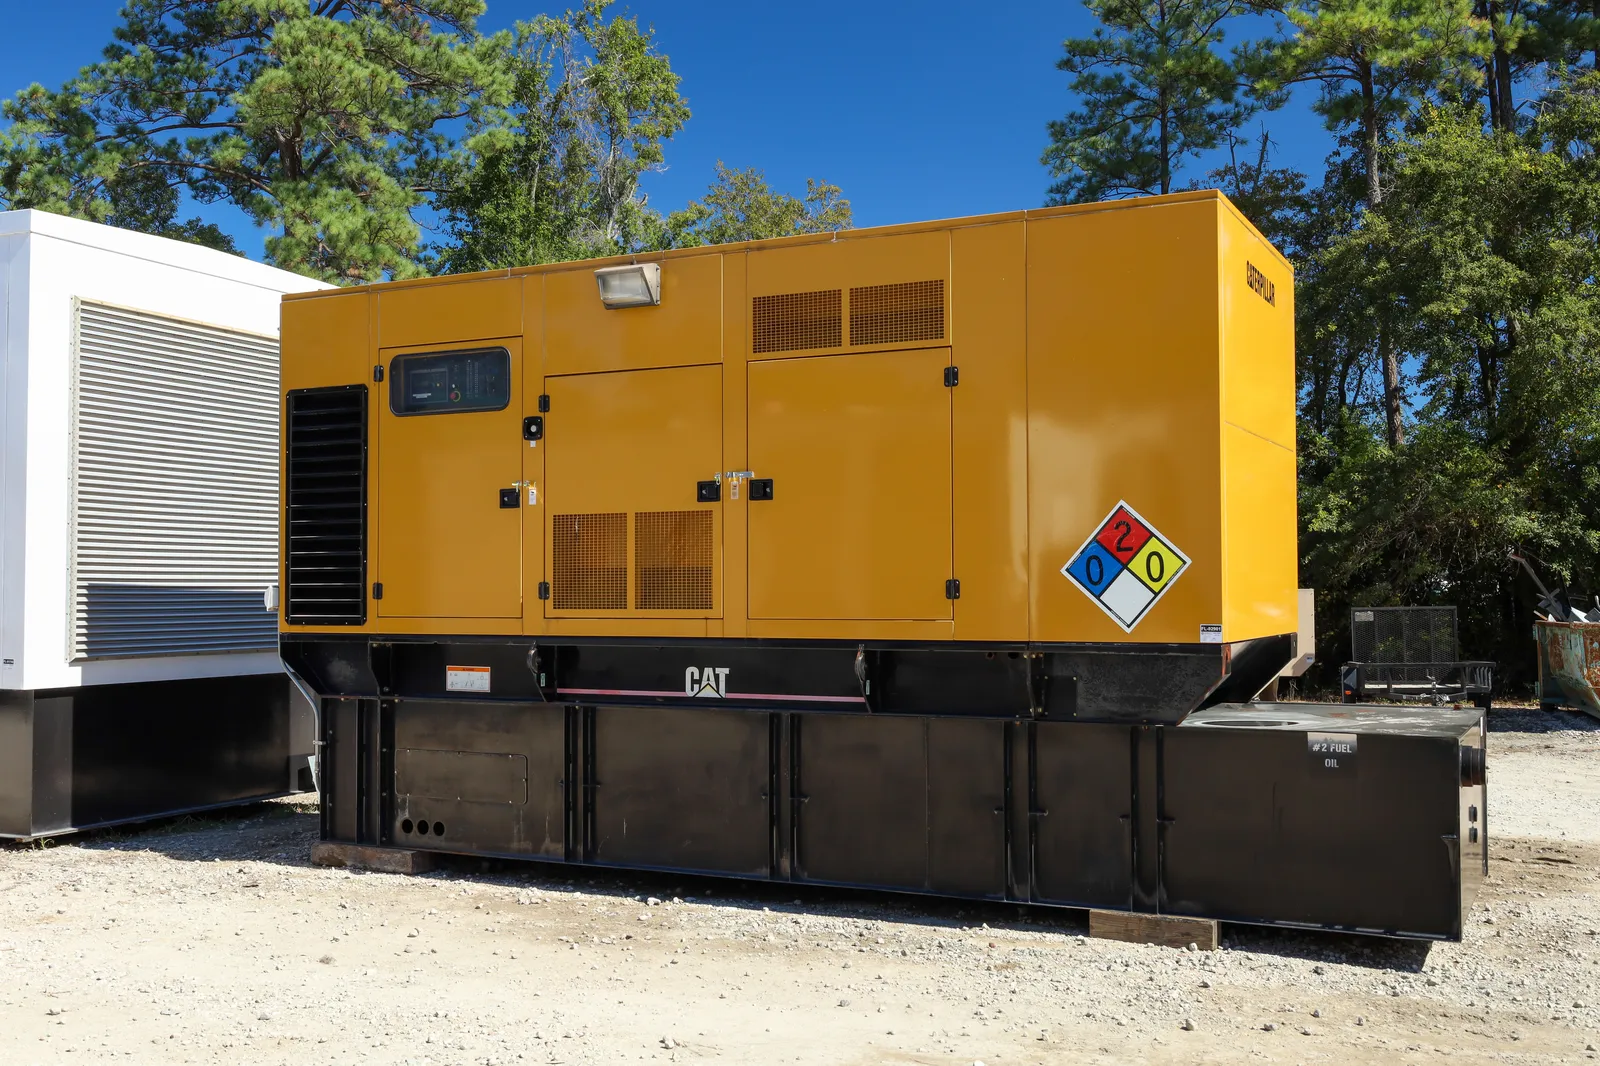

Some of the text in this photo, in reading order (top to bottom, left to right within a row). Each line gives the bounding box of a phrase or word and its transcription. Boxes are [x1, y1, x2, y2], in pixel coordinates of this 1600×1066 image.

[1247, 260, 1275, 308] CATERPILLAR
[1114, 520, 1134, 552] 2
[1086, 554, 1104, 586] 0
[1146, 551, 1165, 583] 0
[685, 666, 730, 698] CAT
[1324, 758, 1340, 768] OIL
[1330, 743, 1352, 753] FUEL
